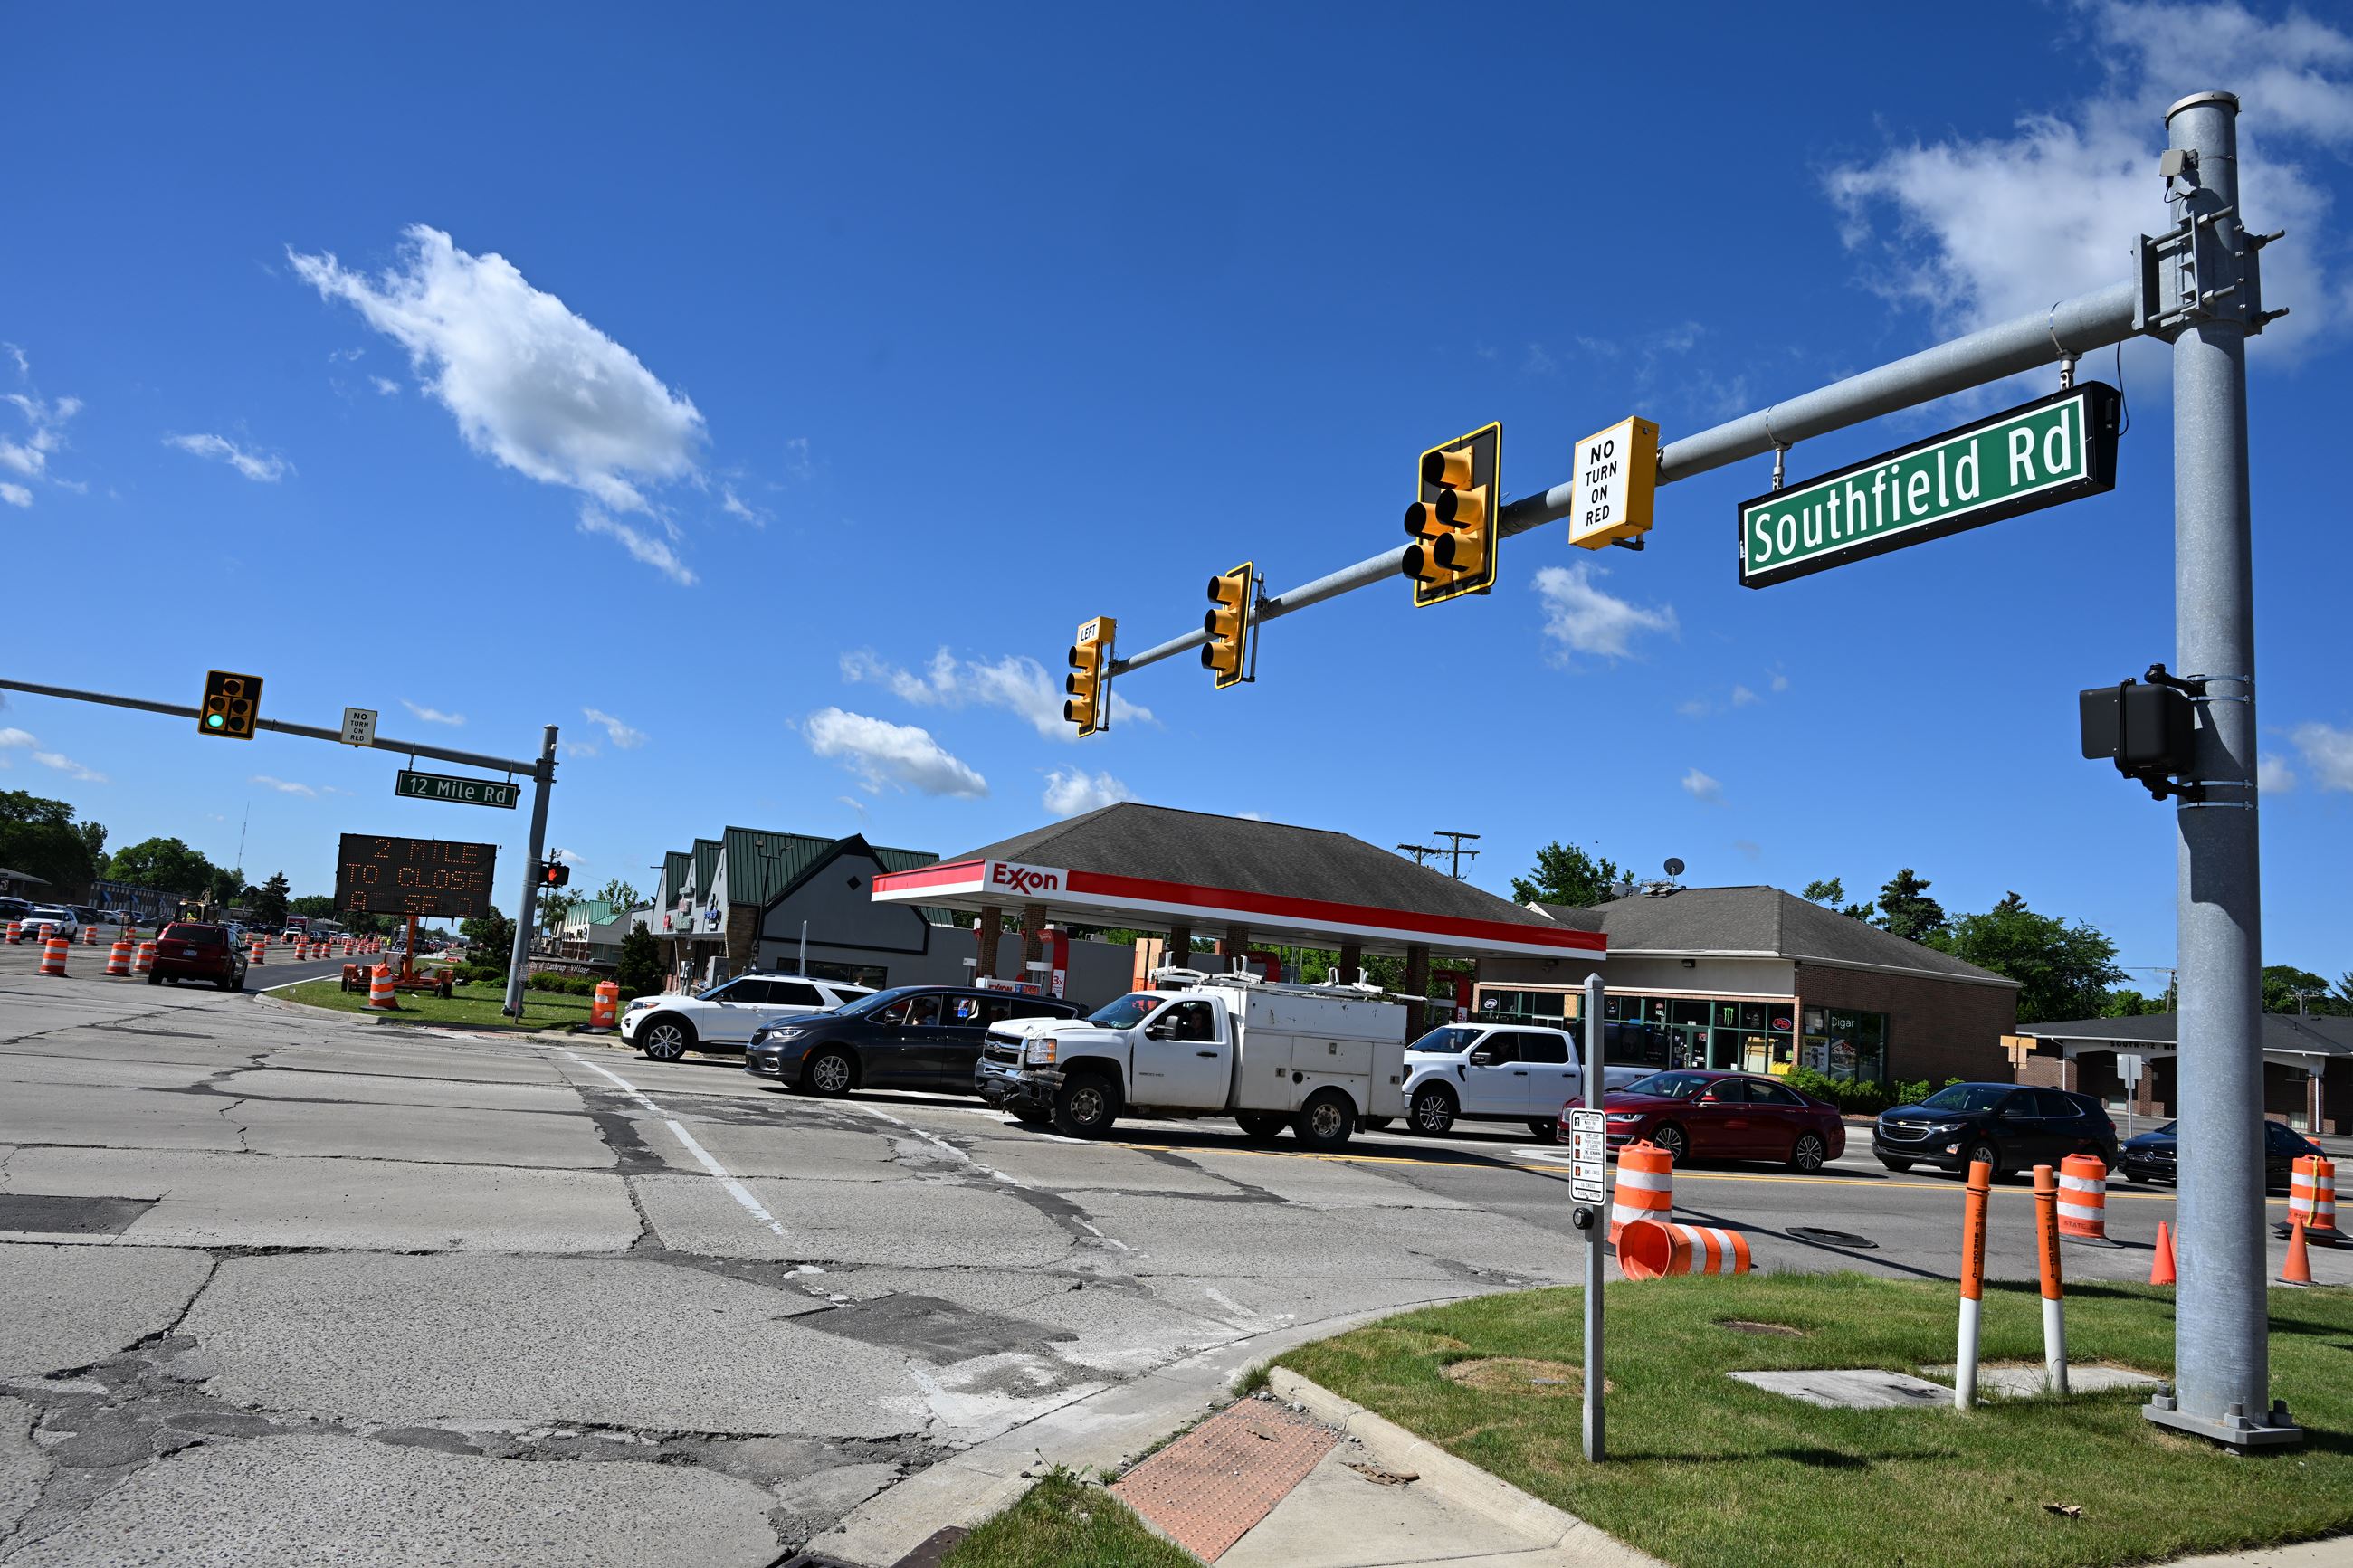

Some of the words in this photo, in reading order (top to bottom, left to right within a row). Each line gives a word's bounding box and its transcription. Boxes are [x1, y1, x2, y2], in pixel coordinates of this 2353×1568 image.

[1590, 439, 1615, 465] NO
[1585, 460, 1617, 487] TURN
[1591, 484, 1608, 504] ON
[1754, 438, 1980, 563] Southfield
[2008, 407, 2072, 487] Rd
[1586, 505, 1610, 527] RED
[1081, 623, 1097, 641] LEFT
[350, 720, 369, 728] TURN
[353, 712, 367, 720] NO
[350, 734, 365, 742] RED
[410, 777, 428, 794] 12
[436, 780, 475, 800] Mile
[483, 785, 507, 803] Rd
[409, 841, 478, 864] MILE
[346, 863, 379, 884] TO
[398, 867, 484, 891] CLOSE
[992, 863, 1058, 896] Exxon
[547, 962, 567, 974] Lathrup
[570, 964, 591, 974] Village
[1773, 1018, 1790, 1029] OPEN
[1831, 1016, 1855, 1030] Cigar
[2110, 1041, 2156, 1050] SOUTH-12
